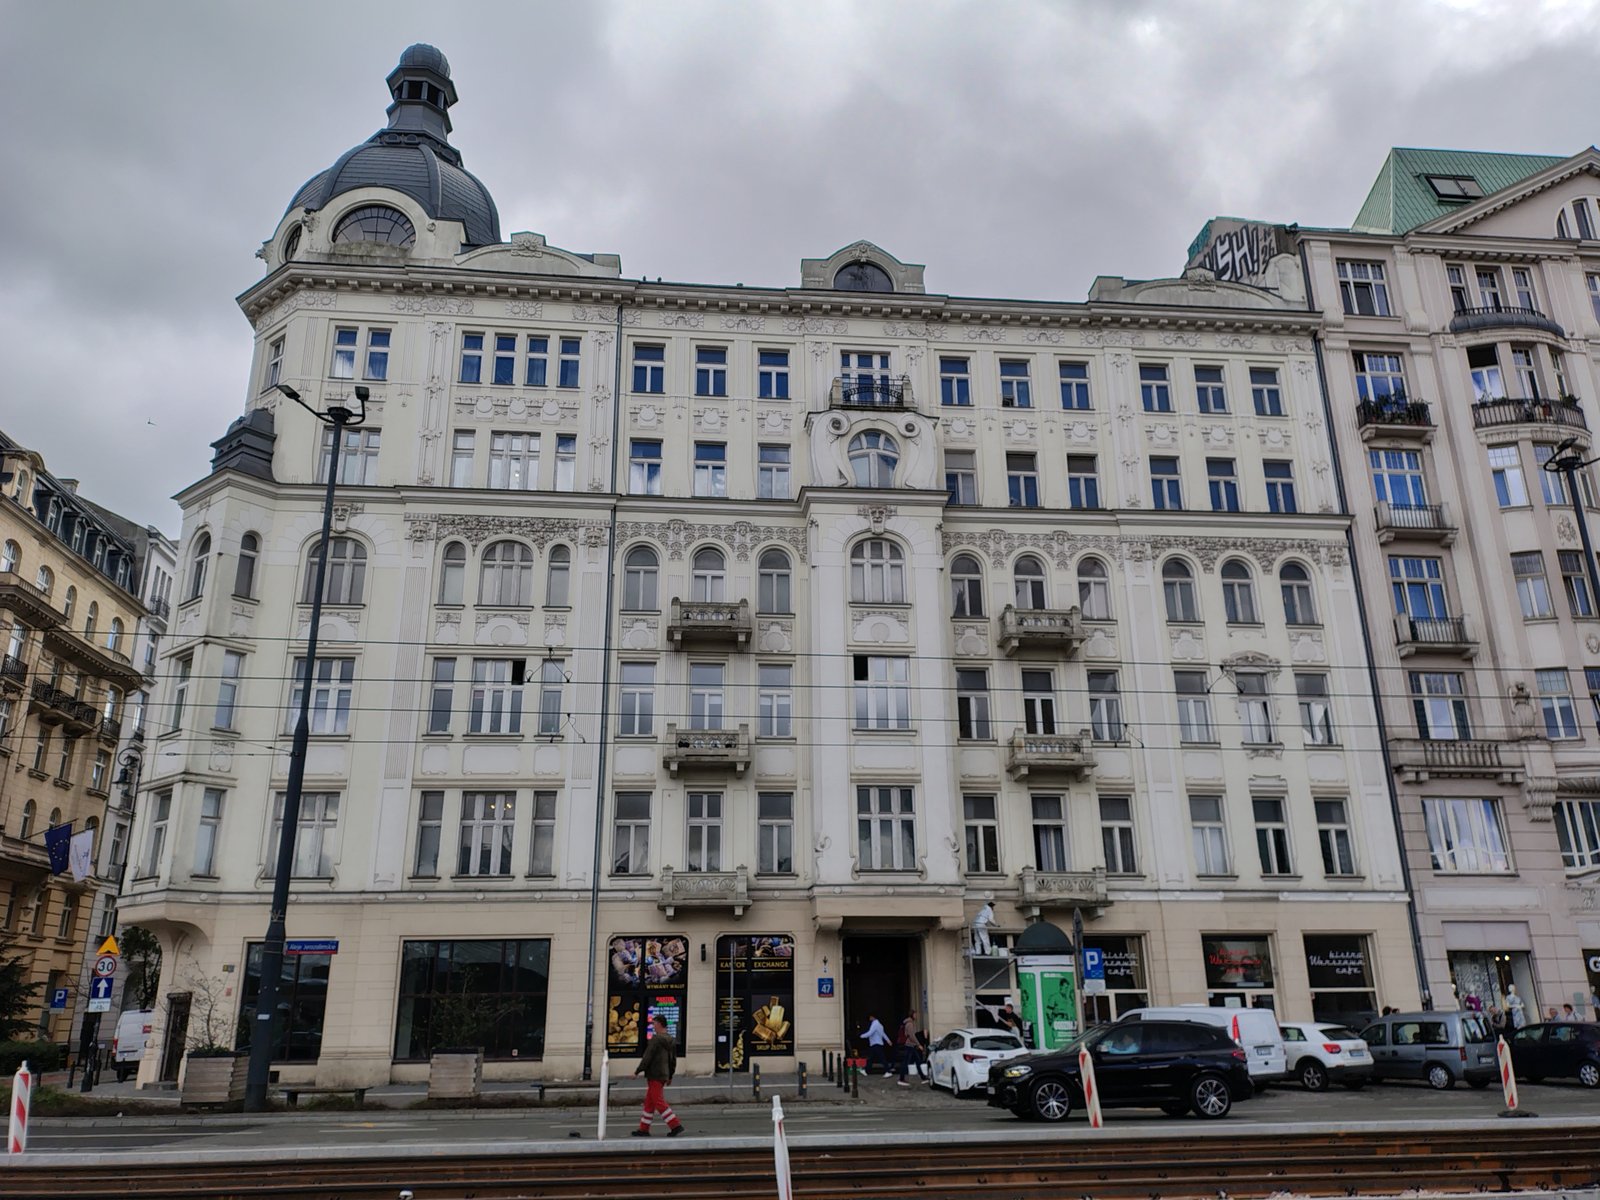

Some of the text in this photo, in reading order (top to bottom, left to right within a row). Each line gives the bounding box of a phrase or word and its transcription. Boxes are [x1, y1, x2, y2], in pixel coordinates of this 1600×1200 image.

[1085, 951, 1099, 971] P
[1308, 955, 1366, 966] Warszawa
[98, 961, 113, 972] 30
[821, 983, 831, 994] 47
[54, 990, 65, 1003] P
